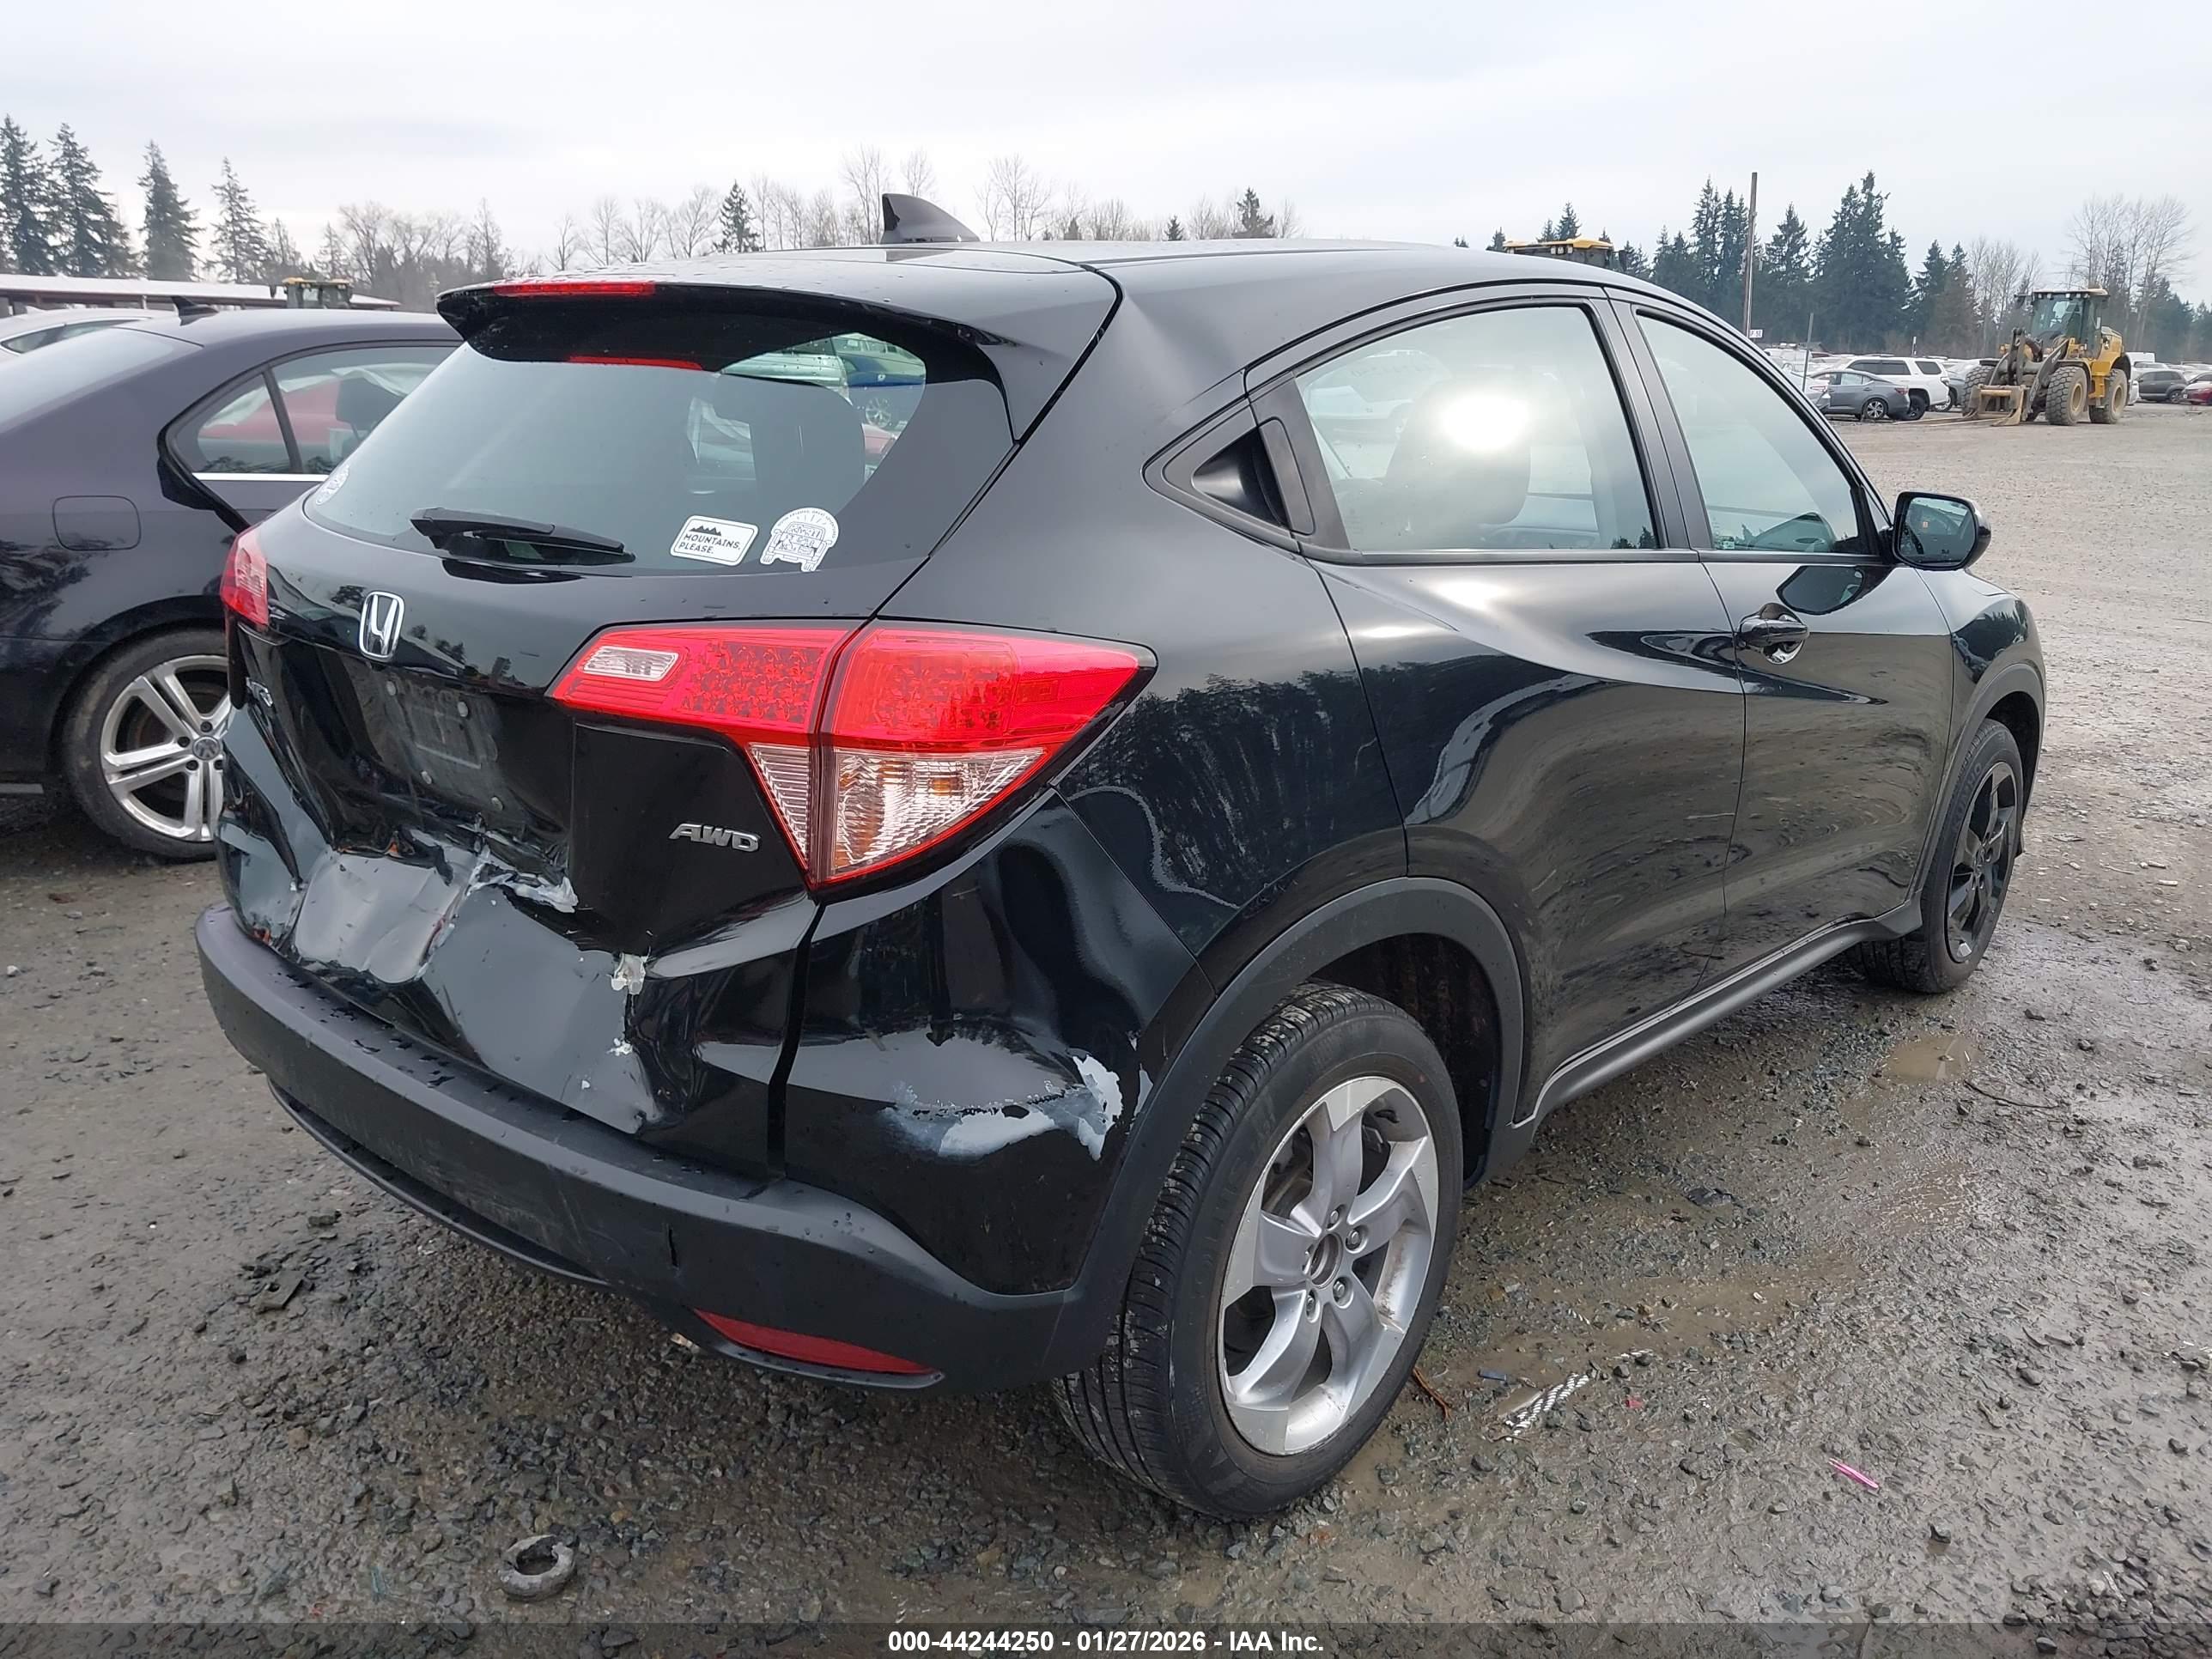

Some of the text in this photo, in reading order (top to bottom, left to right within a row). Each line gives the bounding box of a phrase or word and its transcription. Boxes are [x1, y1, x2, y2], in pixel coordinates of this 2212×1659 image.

[678, 542, 714, 554] PLEASE.
[683, 533, 741, 550] MOUNTAINS.
[668, 823, 760, 852] AWD
